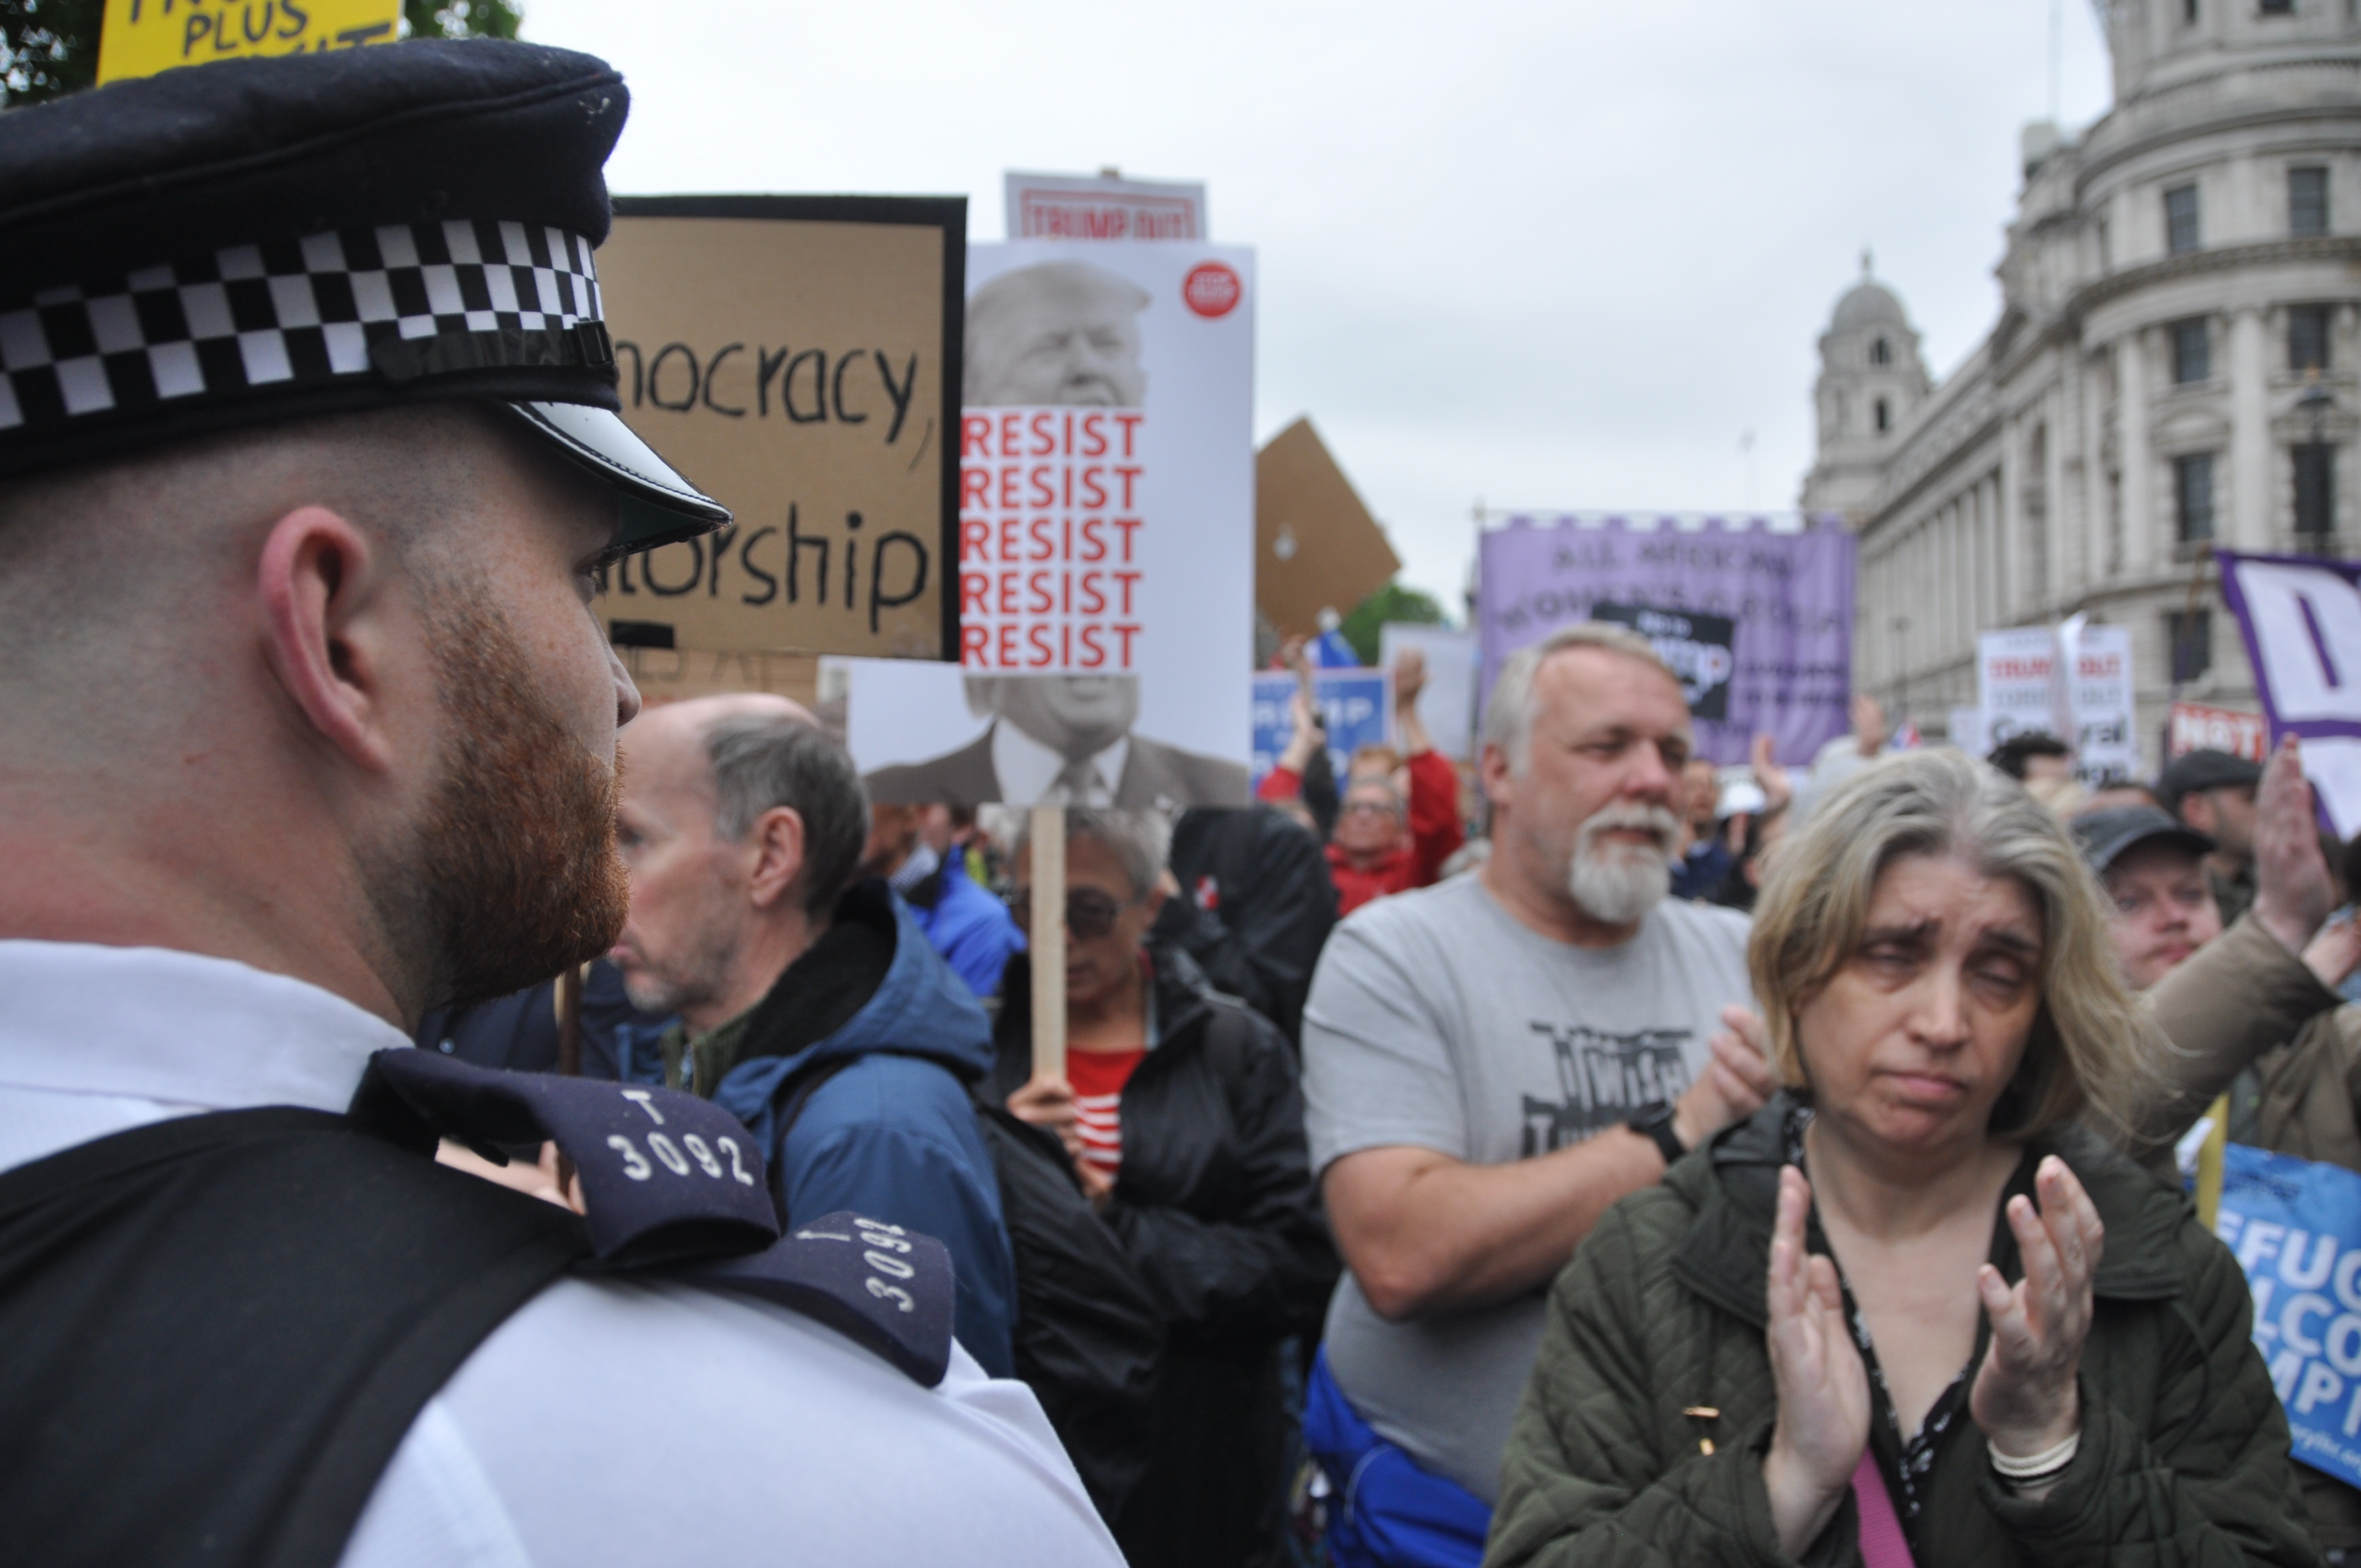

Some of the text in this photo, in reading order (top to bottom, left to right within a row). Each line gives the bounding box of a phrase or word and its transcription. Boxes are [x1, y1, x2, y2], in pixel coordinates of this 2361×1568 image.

[182, 0, 309, 58] PLUS
[961, 413, 1144, 458] RESIST
[960, 465, 1143, 510] RESIST
[960, 518, 1143, 563] RESIST
[960, 570, 1143, 616] RESIST
[960, 623, 1142, 668] RESIST
[622, 1089, 665, 1124] T
[607, 1131, 754, 1186] 3092
